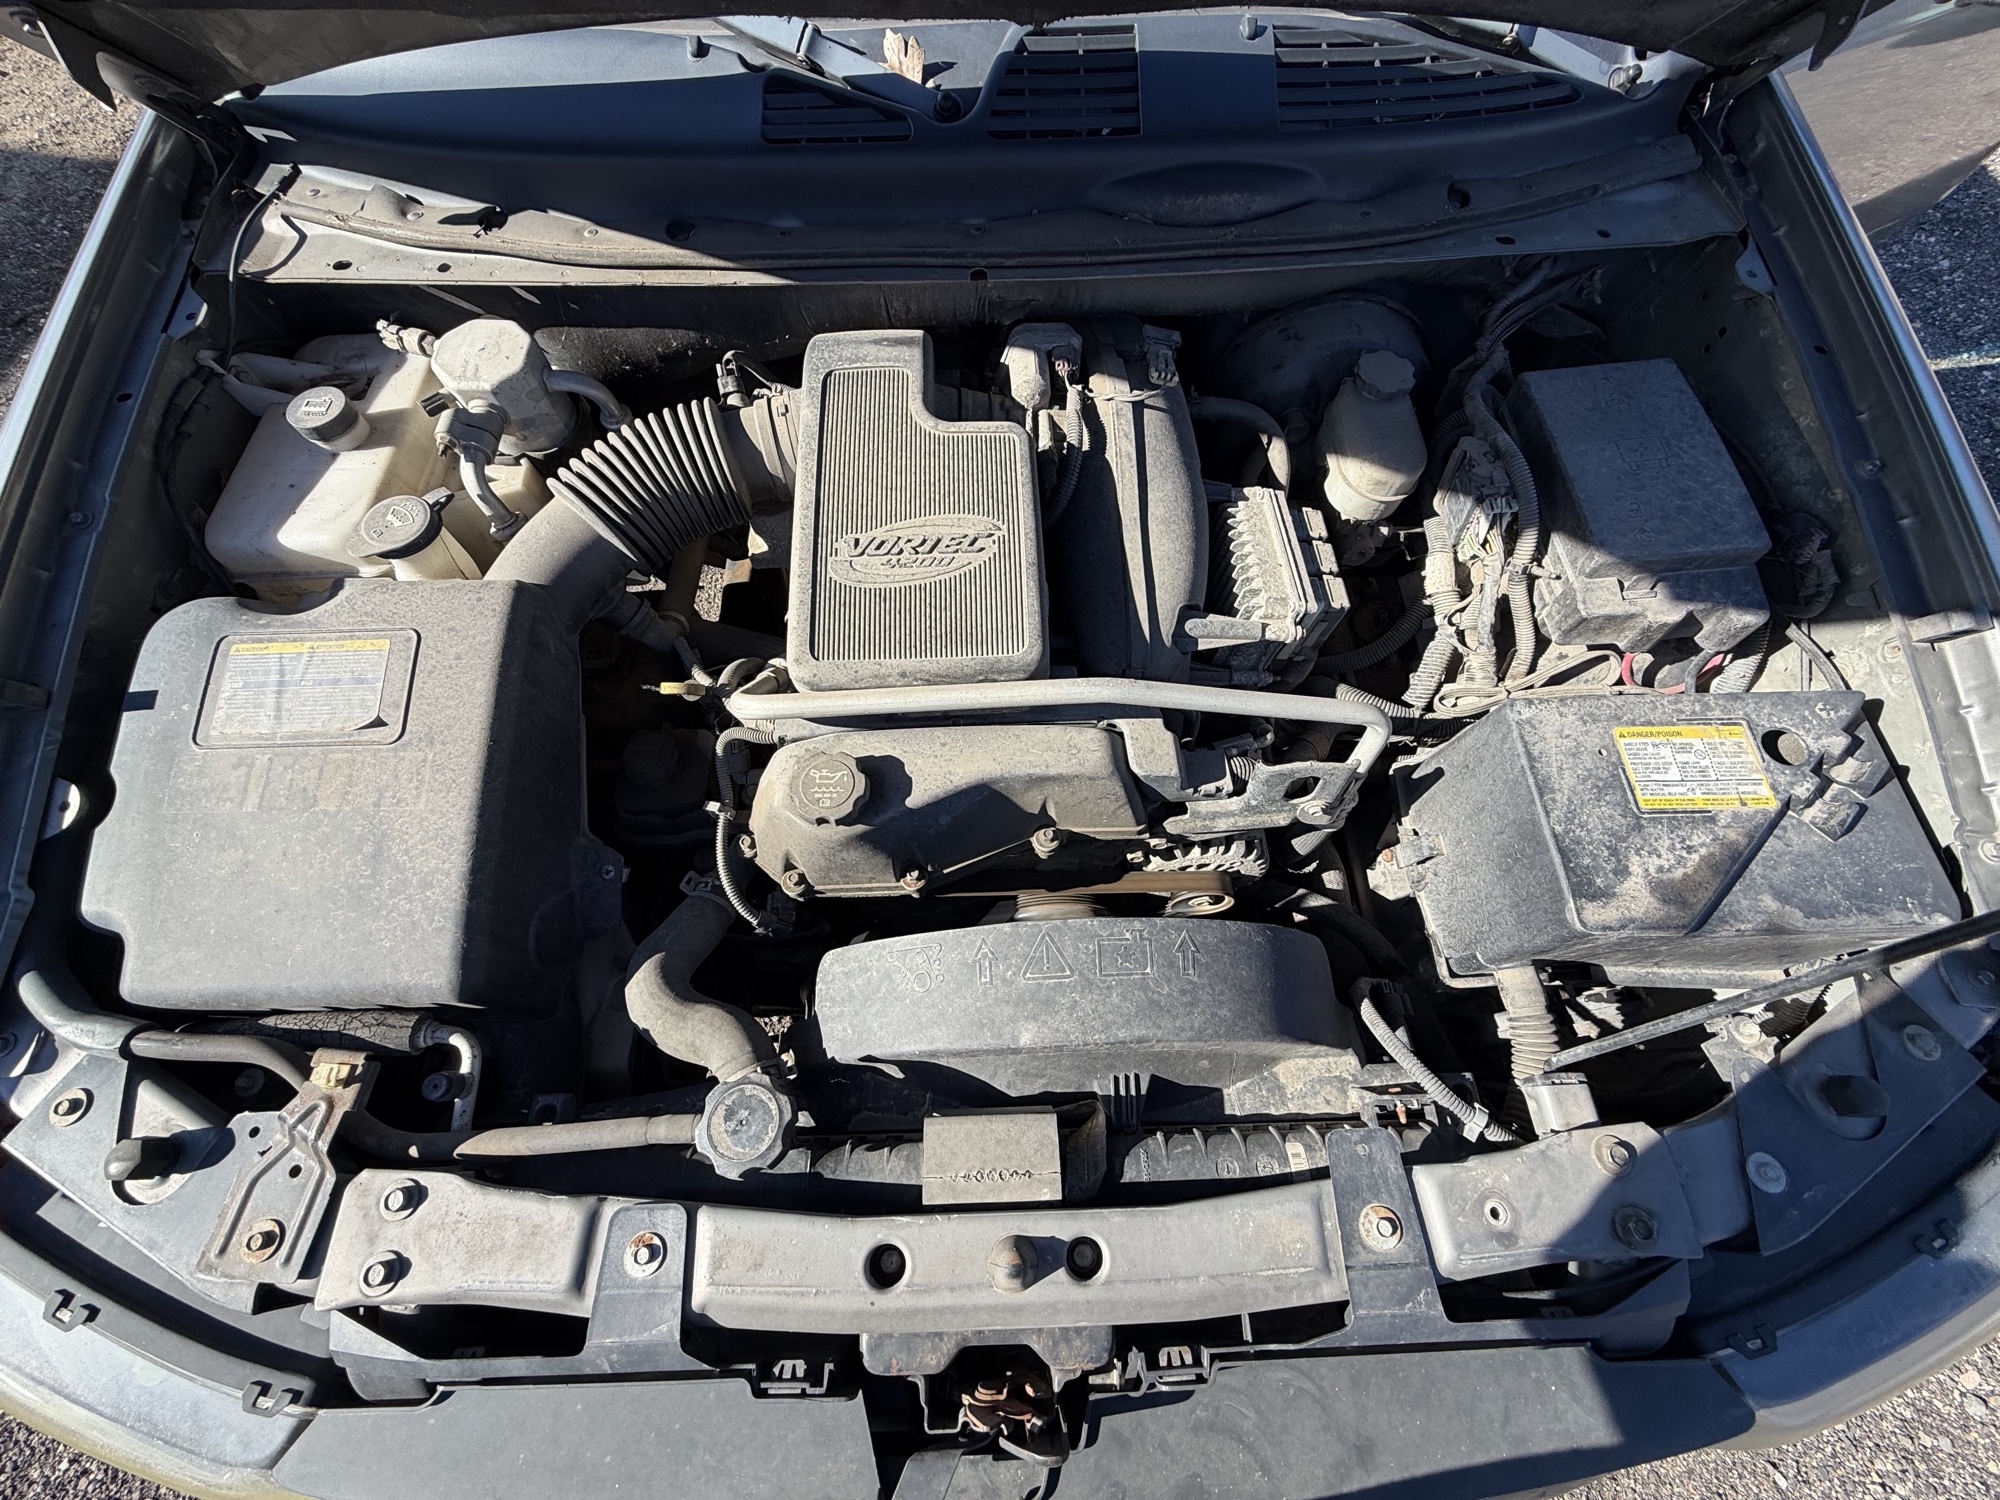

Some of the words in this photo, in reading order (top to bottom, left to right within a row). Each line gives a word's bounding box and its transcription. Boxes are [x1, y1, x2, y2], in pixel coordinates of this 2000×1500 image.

[843, 532, 996, 558] VORTEC
[880, 556, 956, 569] 4200
[1626, 730, 1684, 738] DANGER/POISON
